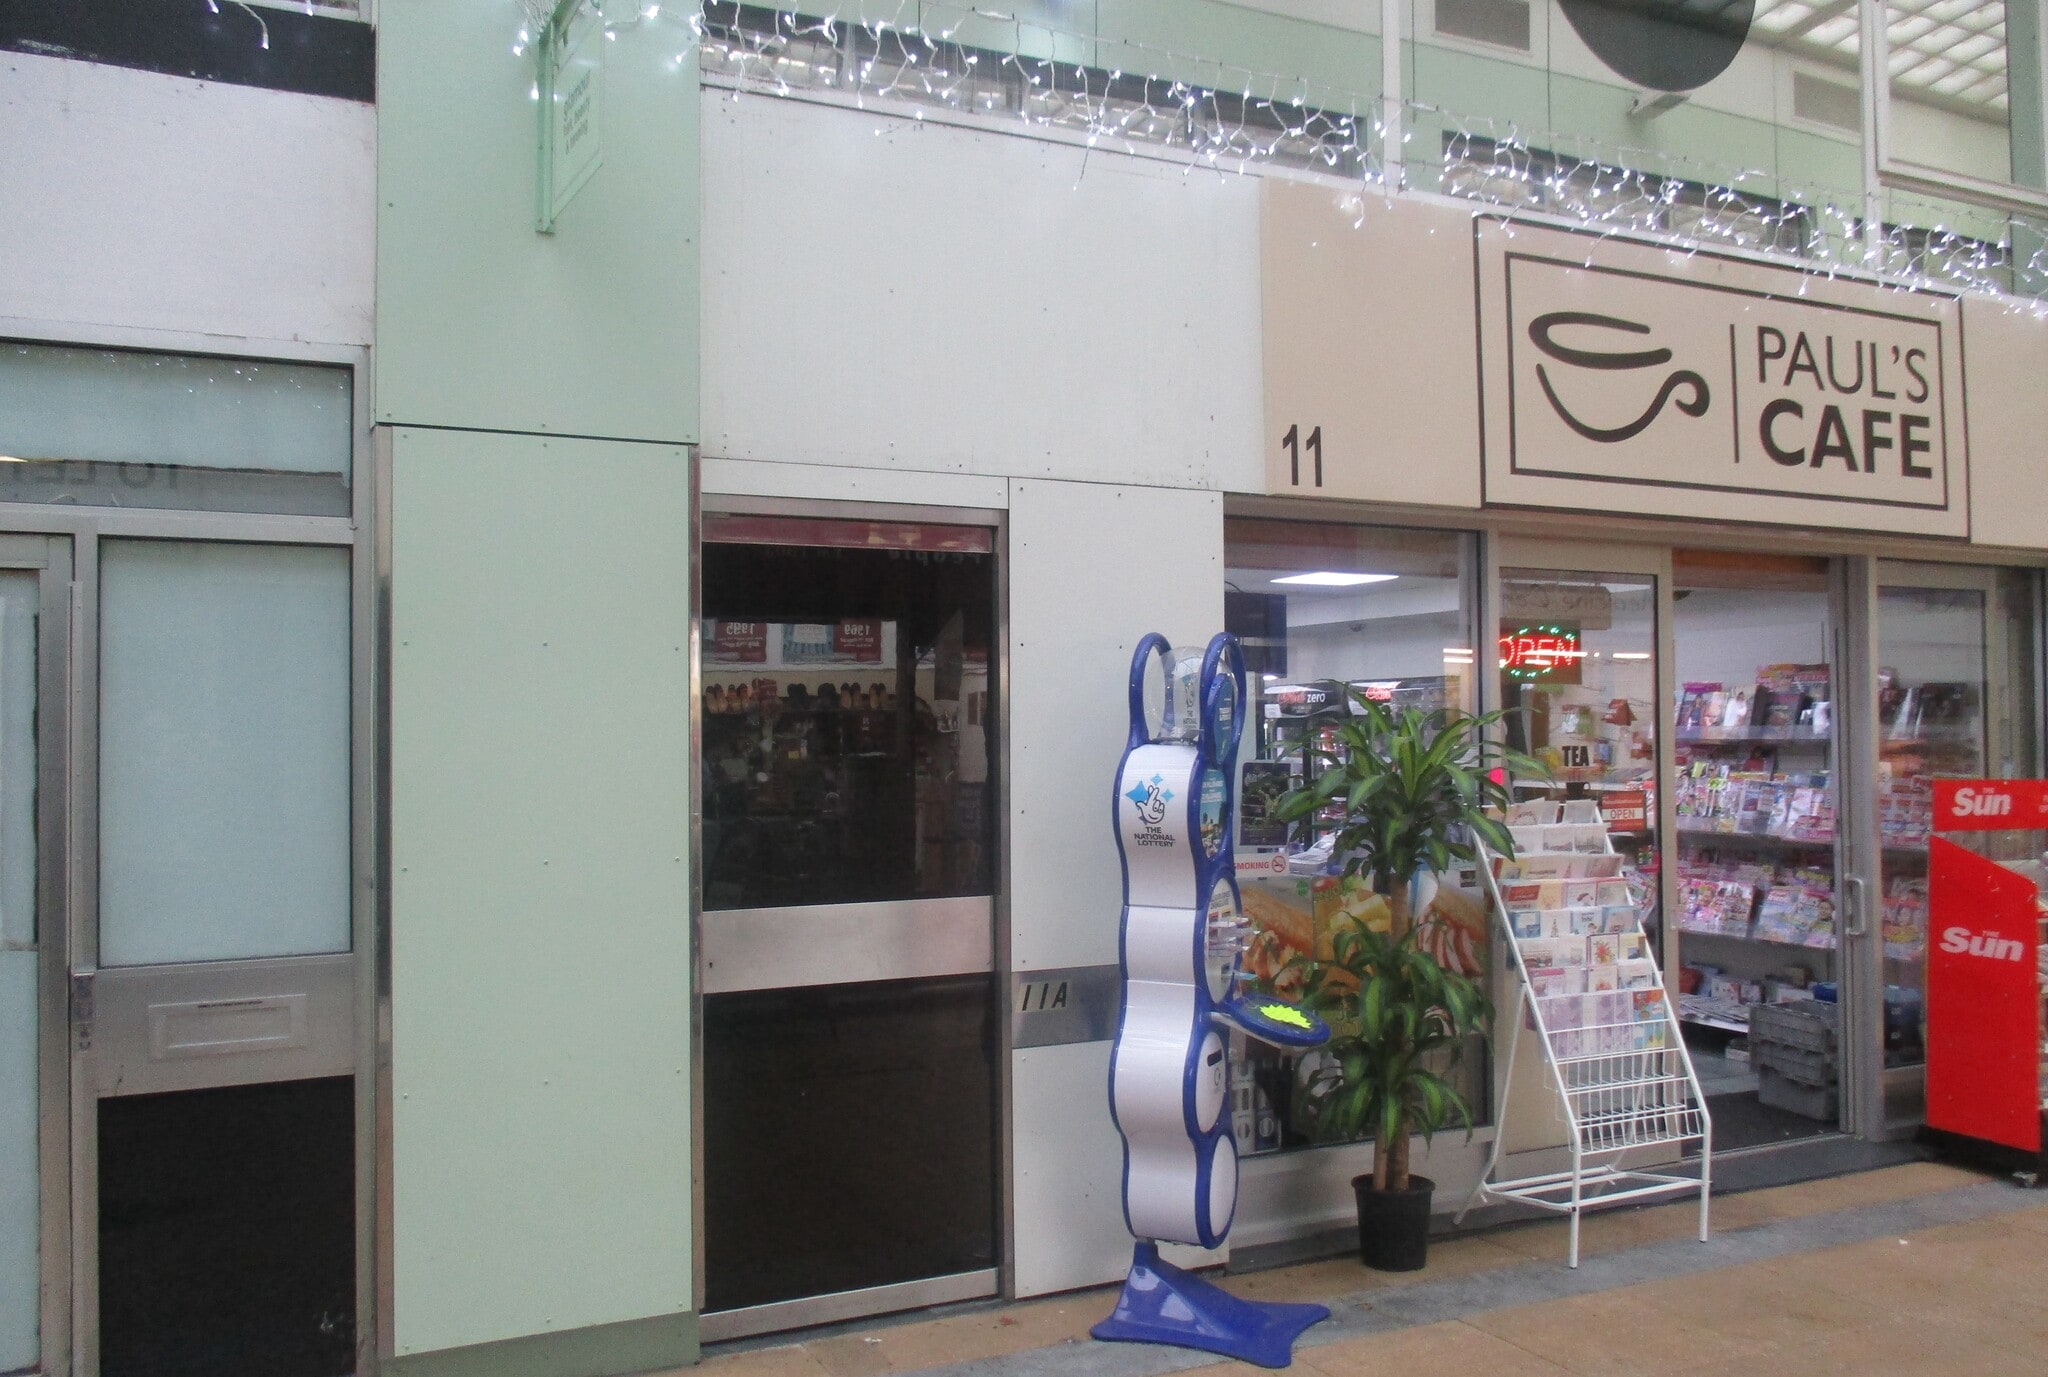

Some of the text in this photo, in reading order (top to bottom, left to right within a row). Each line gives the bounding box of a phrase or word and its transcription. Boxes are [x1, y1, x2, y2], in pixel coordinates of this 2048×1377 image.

[1757, 325, 1930, 404] PAUL'S
[1759, 398, 1933, 479] CAFE
[1281, 424, 1323, 488] 11
[1499, 637, 1575, 666] OPEN
[1306, 692, 1326, 704] zero
[1562, 746, 1590, 766] TEA
[1610, 809, 1635, 819] OPEN
[1952, 787, 2011, 816] Sun
[1134, 833, 1176, 841] NATIONAL
[1939, 926, 2024, 962] Sun
[1022, 981, 1068, 1011] 11A
